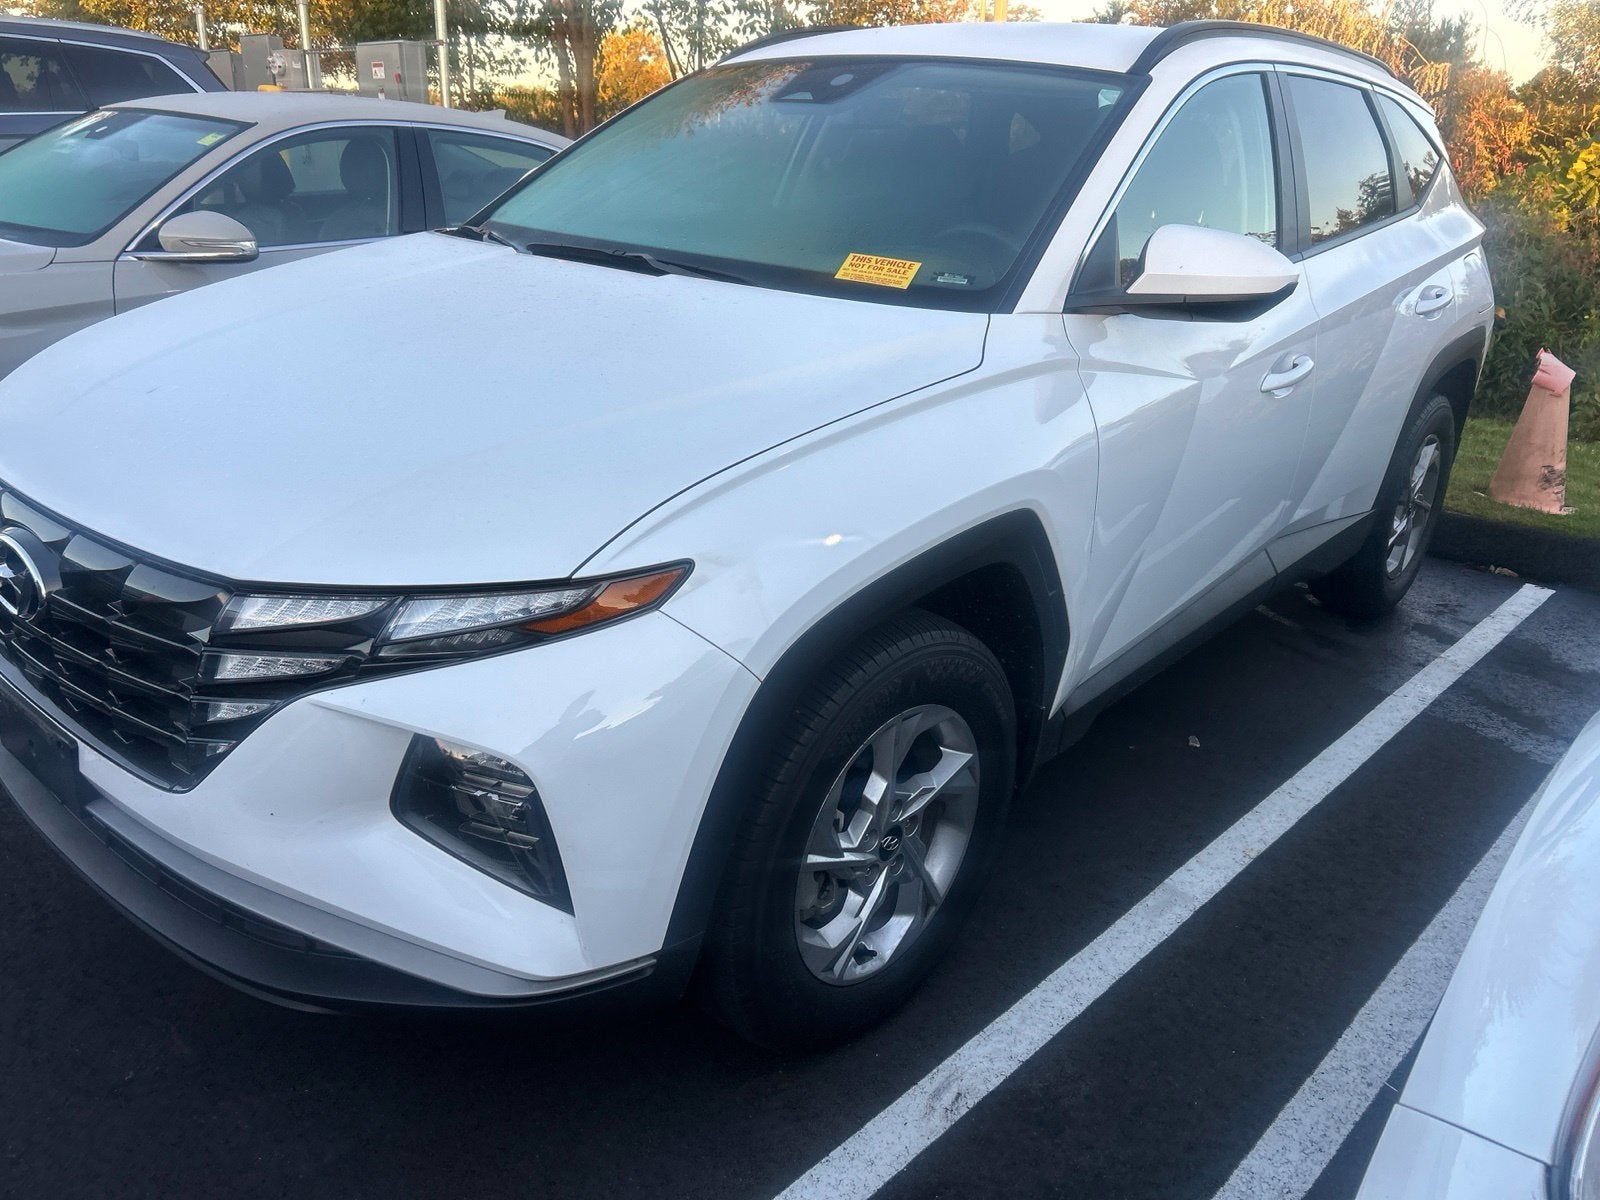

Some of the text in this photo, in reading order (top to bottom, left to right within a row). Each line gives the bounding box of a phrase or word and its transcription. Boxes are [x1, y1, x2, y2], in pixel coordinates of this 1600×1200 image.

[851, 255, 915, 270] THIS VEHICLE
[886, 267, 909, 275] SALE
